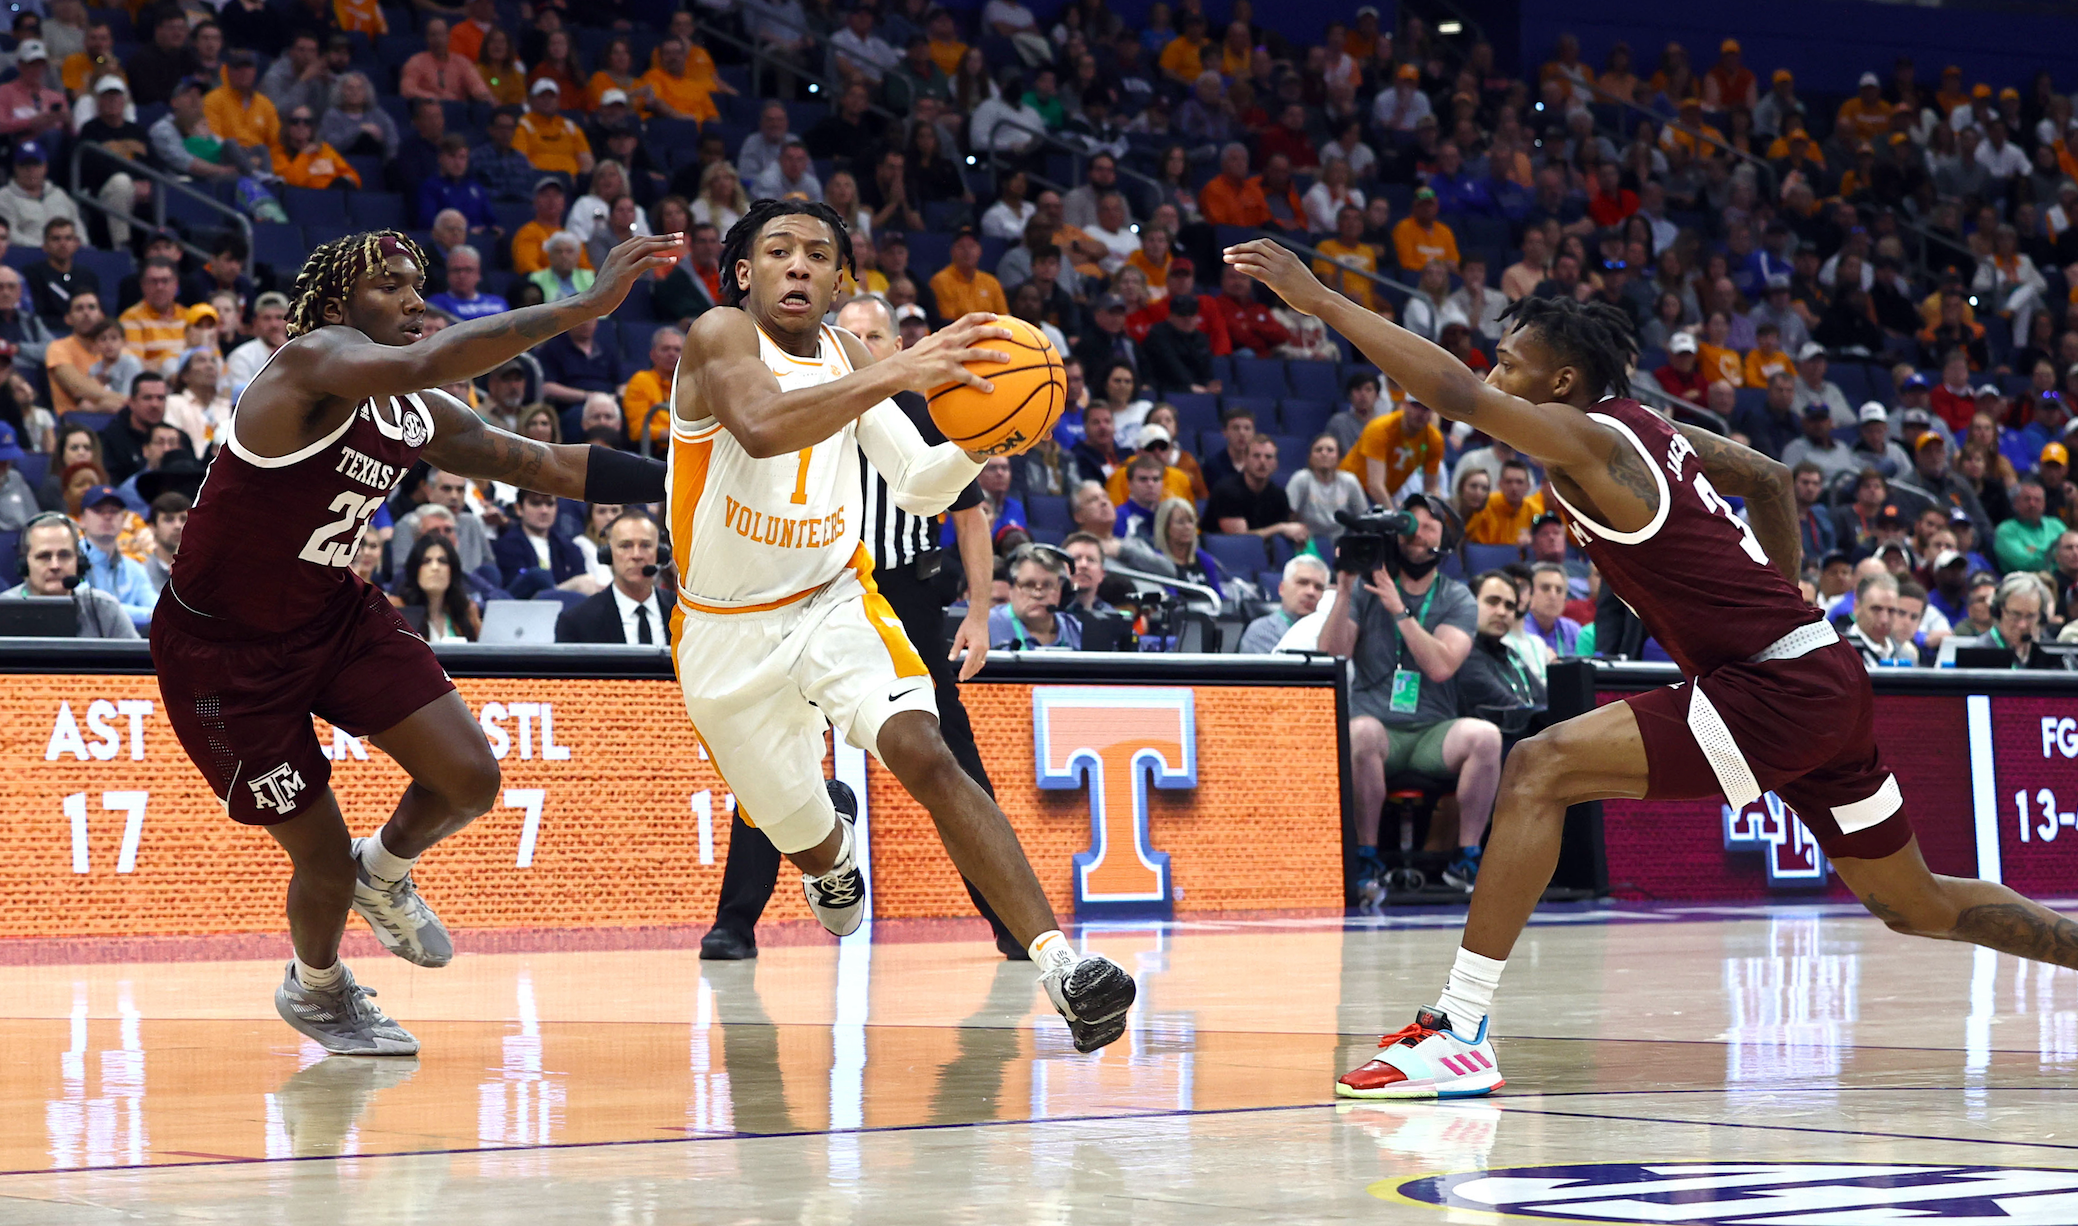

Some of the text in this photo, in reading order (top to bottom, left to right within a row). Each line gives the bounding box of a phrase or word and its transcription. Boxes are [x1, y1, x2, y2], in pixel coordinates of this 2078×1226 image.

[335, 445, 394, 491] TEXAS
[790, 446, 813, 505] 1
[297, 490, 386, 568] 23
[725, 494, 845, 549] VOLUNTEERS
[1692, 471, 1769, 566] 3
[45, 698, 154, 761] AST
[480, 701, 571, 761] STL
[63, 790, 150, 874] 17
[503, 788, 546, 868] 7
[690, 788, 736, 866] 1
[1033, 687, 1197, 910] T
[2014, 788, 2078, 843] 13-
